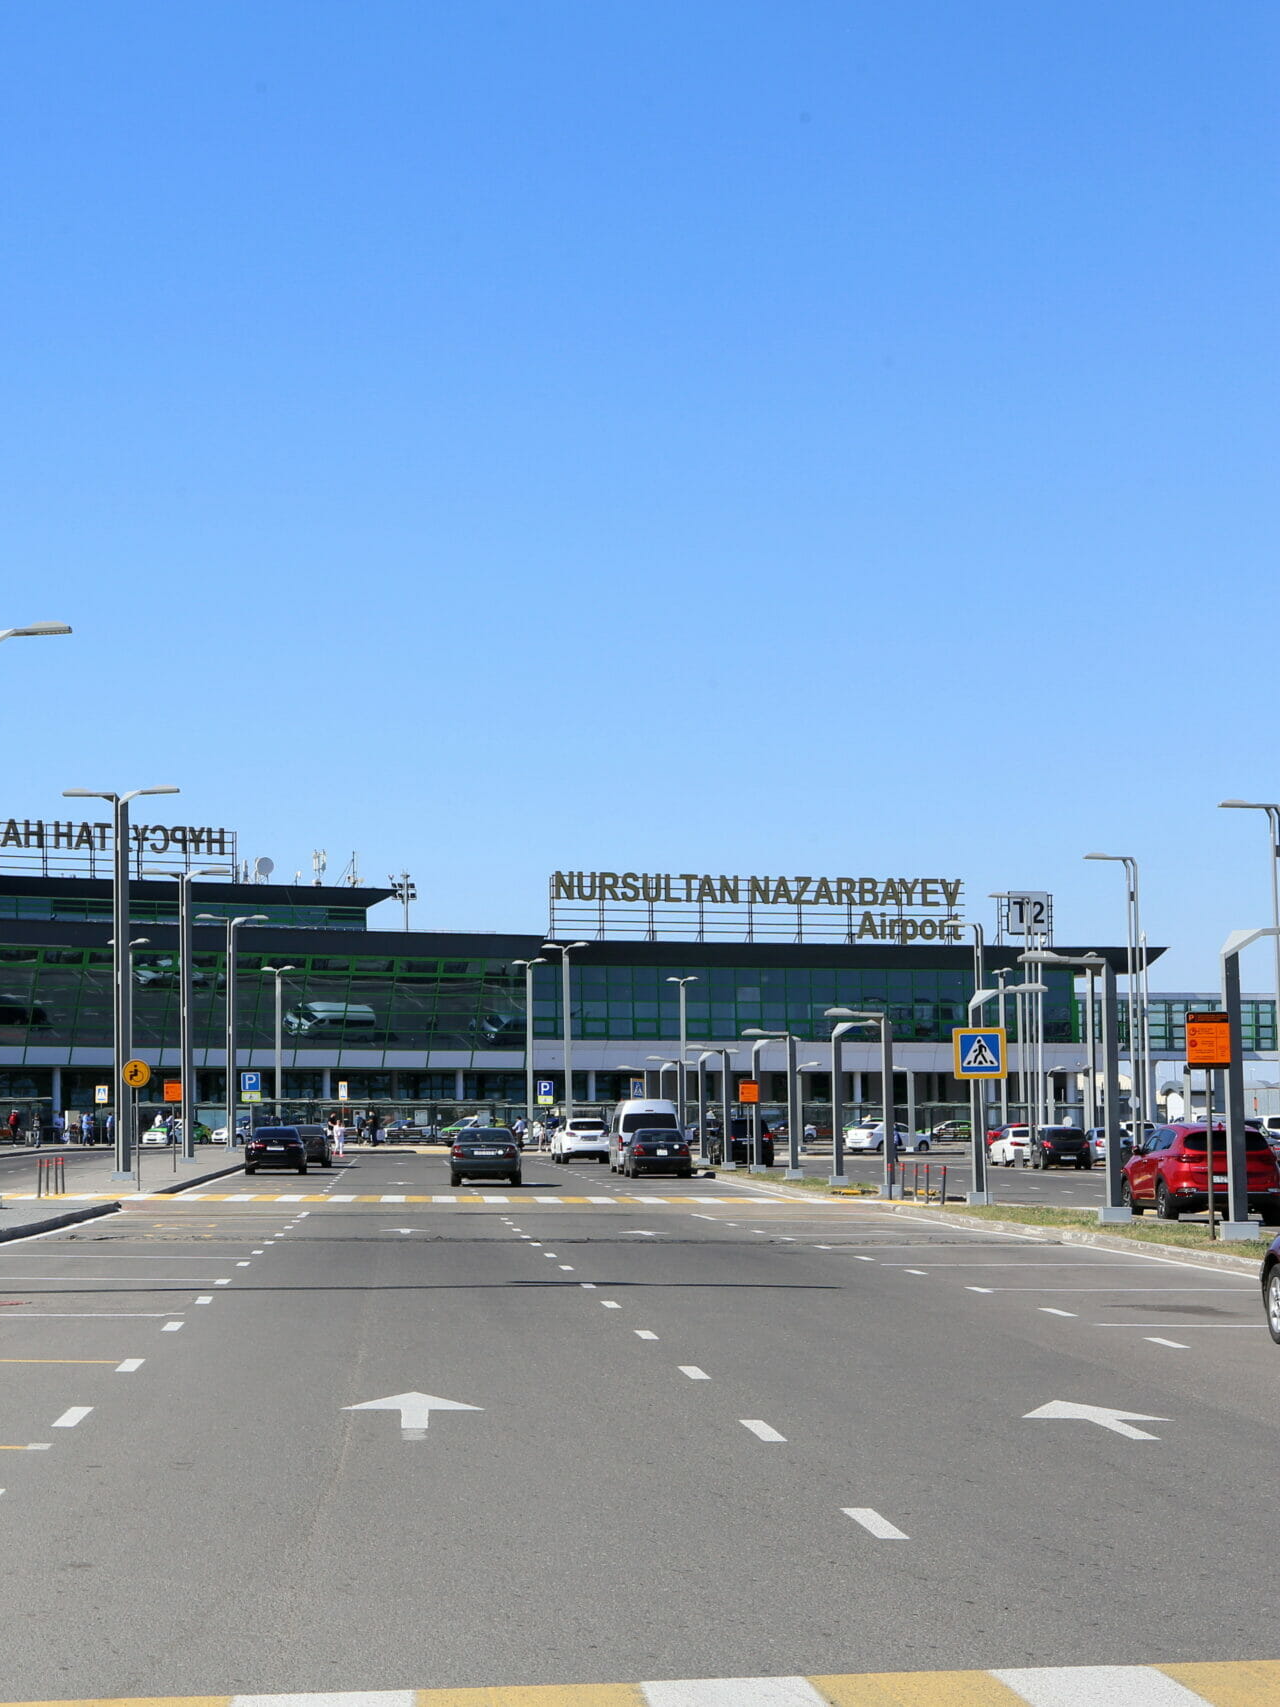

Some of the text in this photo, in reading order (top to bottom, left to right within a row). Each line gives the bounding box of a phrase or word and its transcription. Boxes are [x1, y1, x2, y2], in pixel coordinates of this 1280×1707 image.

[555, 871, 961, 906] NURSULTAN NAZARBAYEV
[1013, 901, 1045, 923] T2
[856, 911, 961, 945] Airport
[245, 1074, 256, 1090] P
[541, 1082, 550, 1095] P
